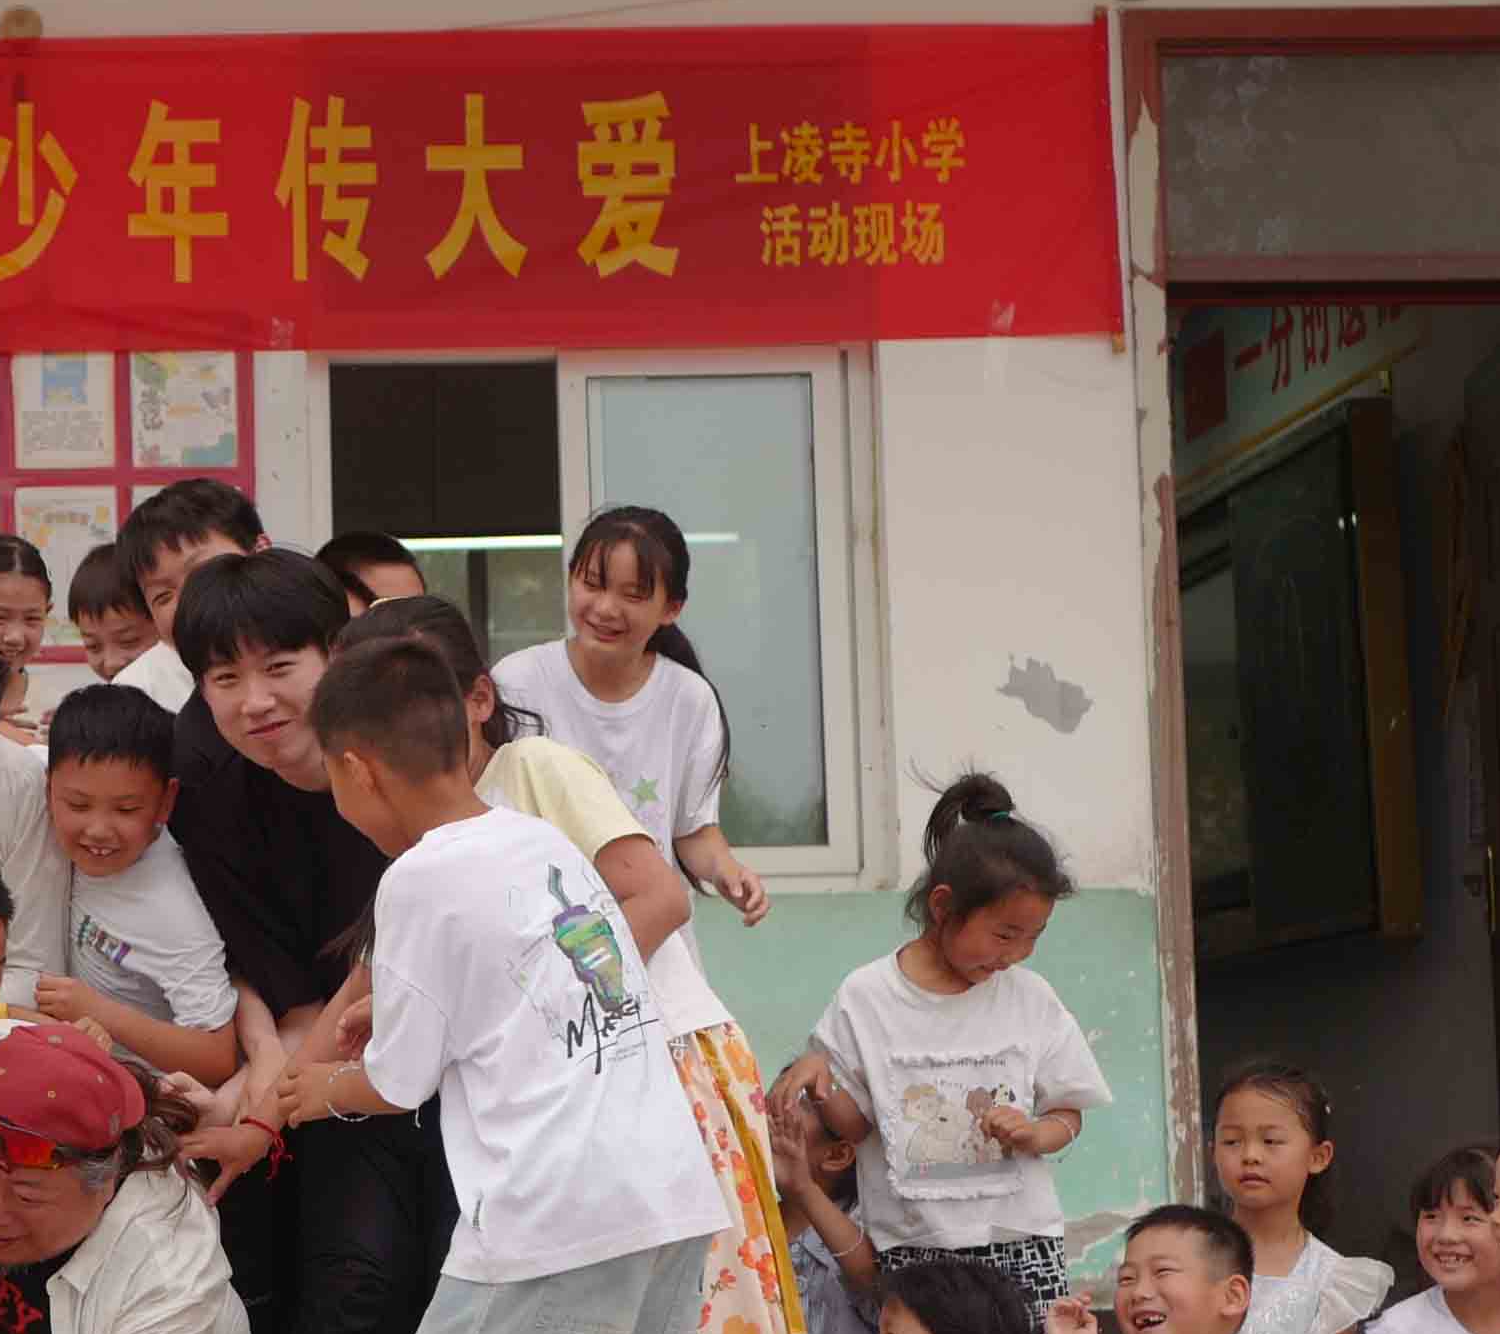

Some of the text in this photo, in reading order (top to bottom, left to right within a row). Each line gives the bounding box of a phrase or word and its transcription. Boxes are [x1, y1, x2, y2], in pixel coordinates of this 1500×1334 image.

[734, 118, 966, 185] 上凌寺小学
[758, 199, 946, 268] 活动现场
